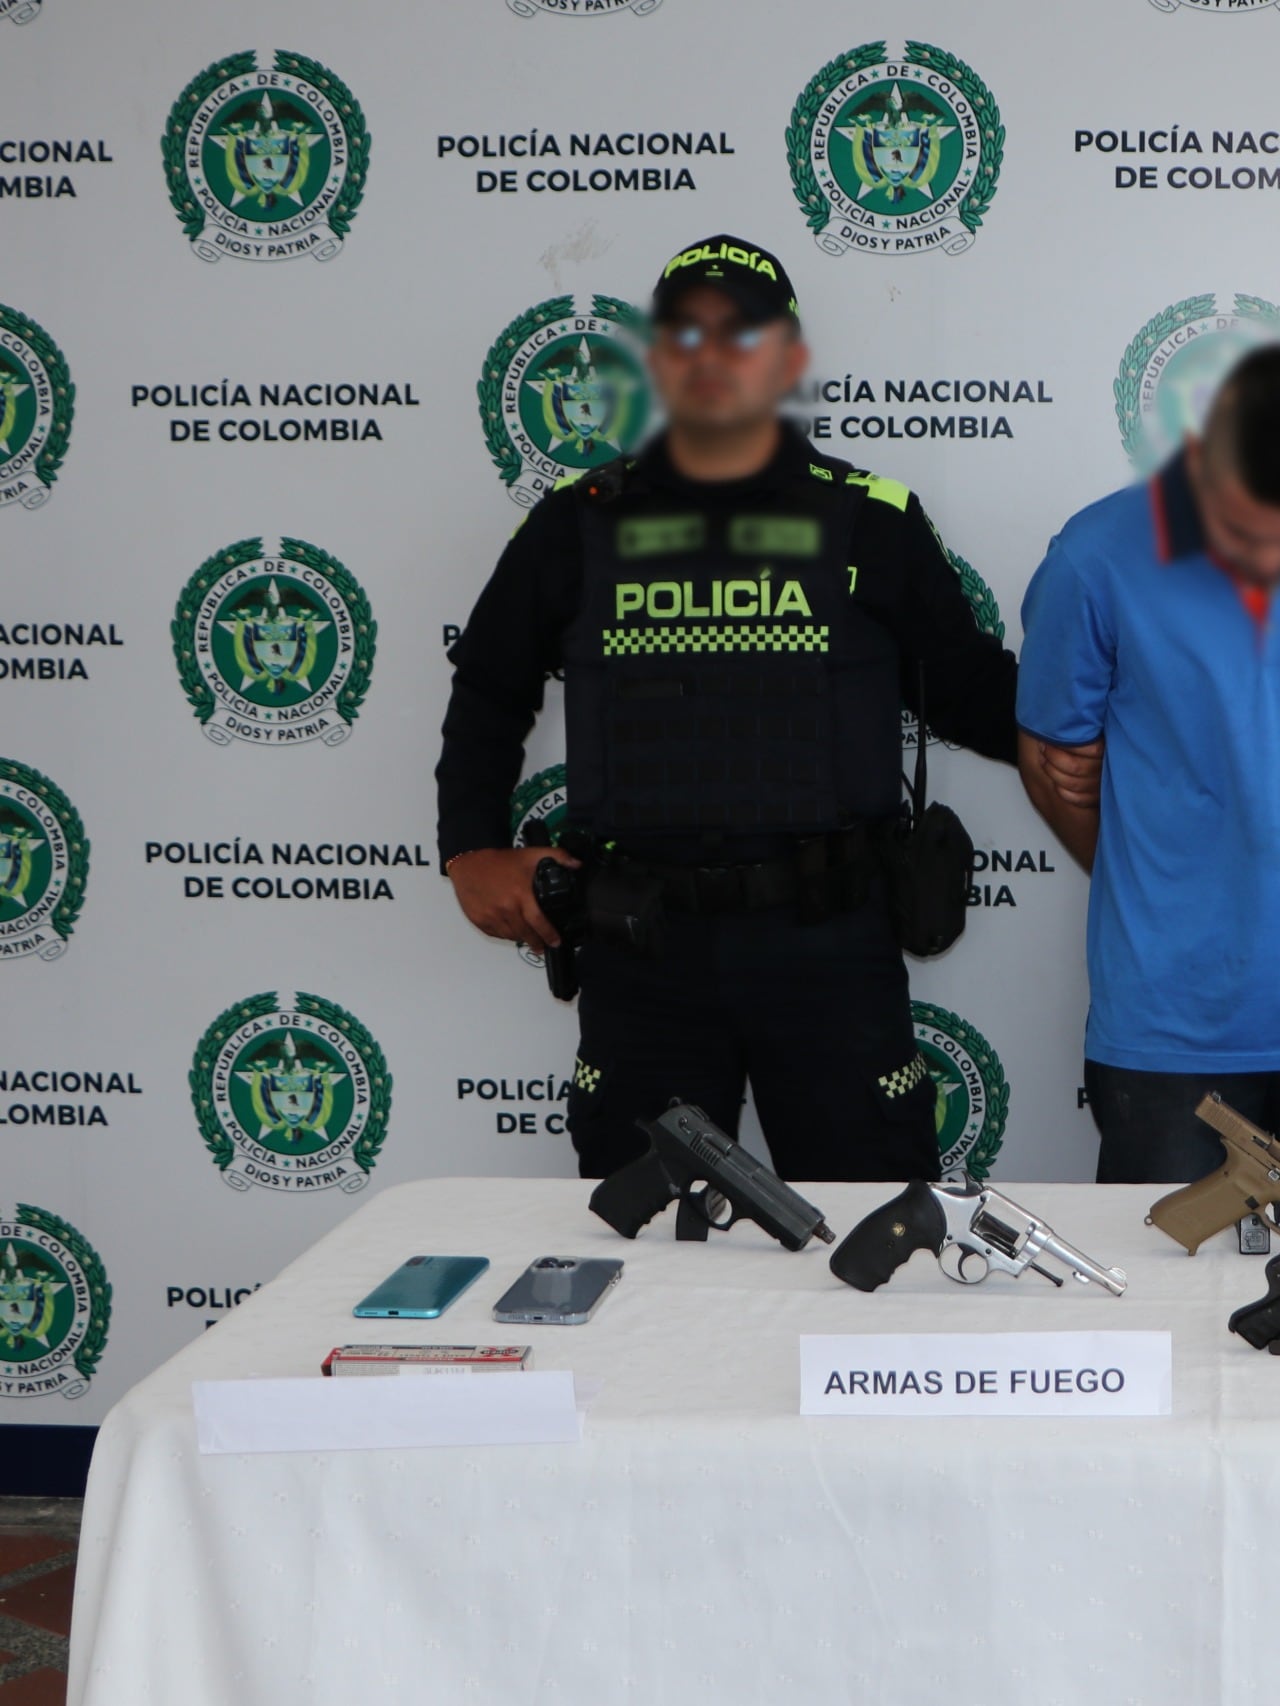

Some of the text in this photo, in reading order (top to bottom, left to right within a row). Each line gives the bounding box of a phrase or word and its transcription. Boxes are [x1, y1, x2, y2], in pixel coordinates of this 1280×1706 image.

[256, 74, 279, 86] DE
[296, 83, 345, 167] COLOMBIA
[886, 65, 910, 78] DE
[927, 74, 977, 160] COLOMBIA
[0, 140, 113, 164] CIONAL
[437, 128, 735, 159] POLICÍA NACIONAL
[1074, 124, 1204, 154] POLICÍA
[476, 168, 697, 193] DE COLOMBIA
[1115, 165, 1159, 189] DE
[268, 185, 338, 237] NACIONAL
[896, 178, 970, 230] NACIONAL
[268, 232, 321, 257] PATRIA
[895, 225, 951, 251] PATRIA
[574, 319, 597, 332] DE
[1, 333, 51, 417] COLOMBIA
[131, 378, 420, 408] POLICÍA NACIONAL
[884, 379, 1054, 404] NACIONAL
[170, 418, 383, 442] DE COLOMBIA
[839, 415, 1014, 439] COLOMBIA
[263, 561, 286, 573] DE
[302, 570, 352, 654] COLOMBIA
[616, 572, 812, 620] POLICÍA
[277, 671, 346, 721] NACIONAL
[278, 717, 330, 741] PATRIA
[16, 789, 66, 871] COLOMBIA
[145, 836, 431, 867] POLICÍA NACIONAL
[184, 876, 395, 901] DE COLOMBIA
[279, 1014, 301, 1027] DE
[317, 1024, 368, 1105] COLOMBIA
[932, 1033, 983, 1115] COLOMBIA
[496, 1112, 538, 1134] DE
[295, 1122, 362, 1169] NACIONAL
[296, 1166, 348, 1188] PATRIA
[38, 1235, 88, 1314] COLOMBIA
[17, 1330, 83, 1375] NACIONAL
[823, 1368, 1125, 1395] ARMAS DE FUEGO
